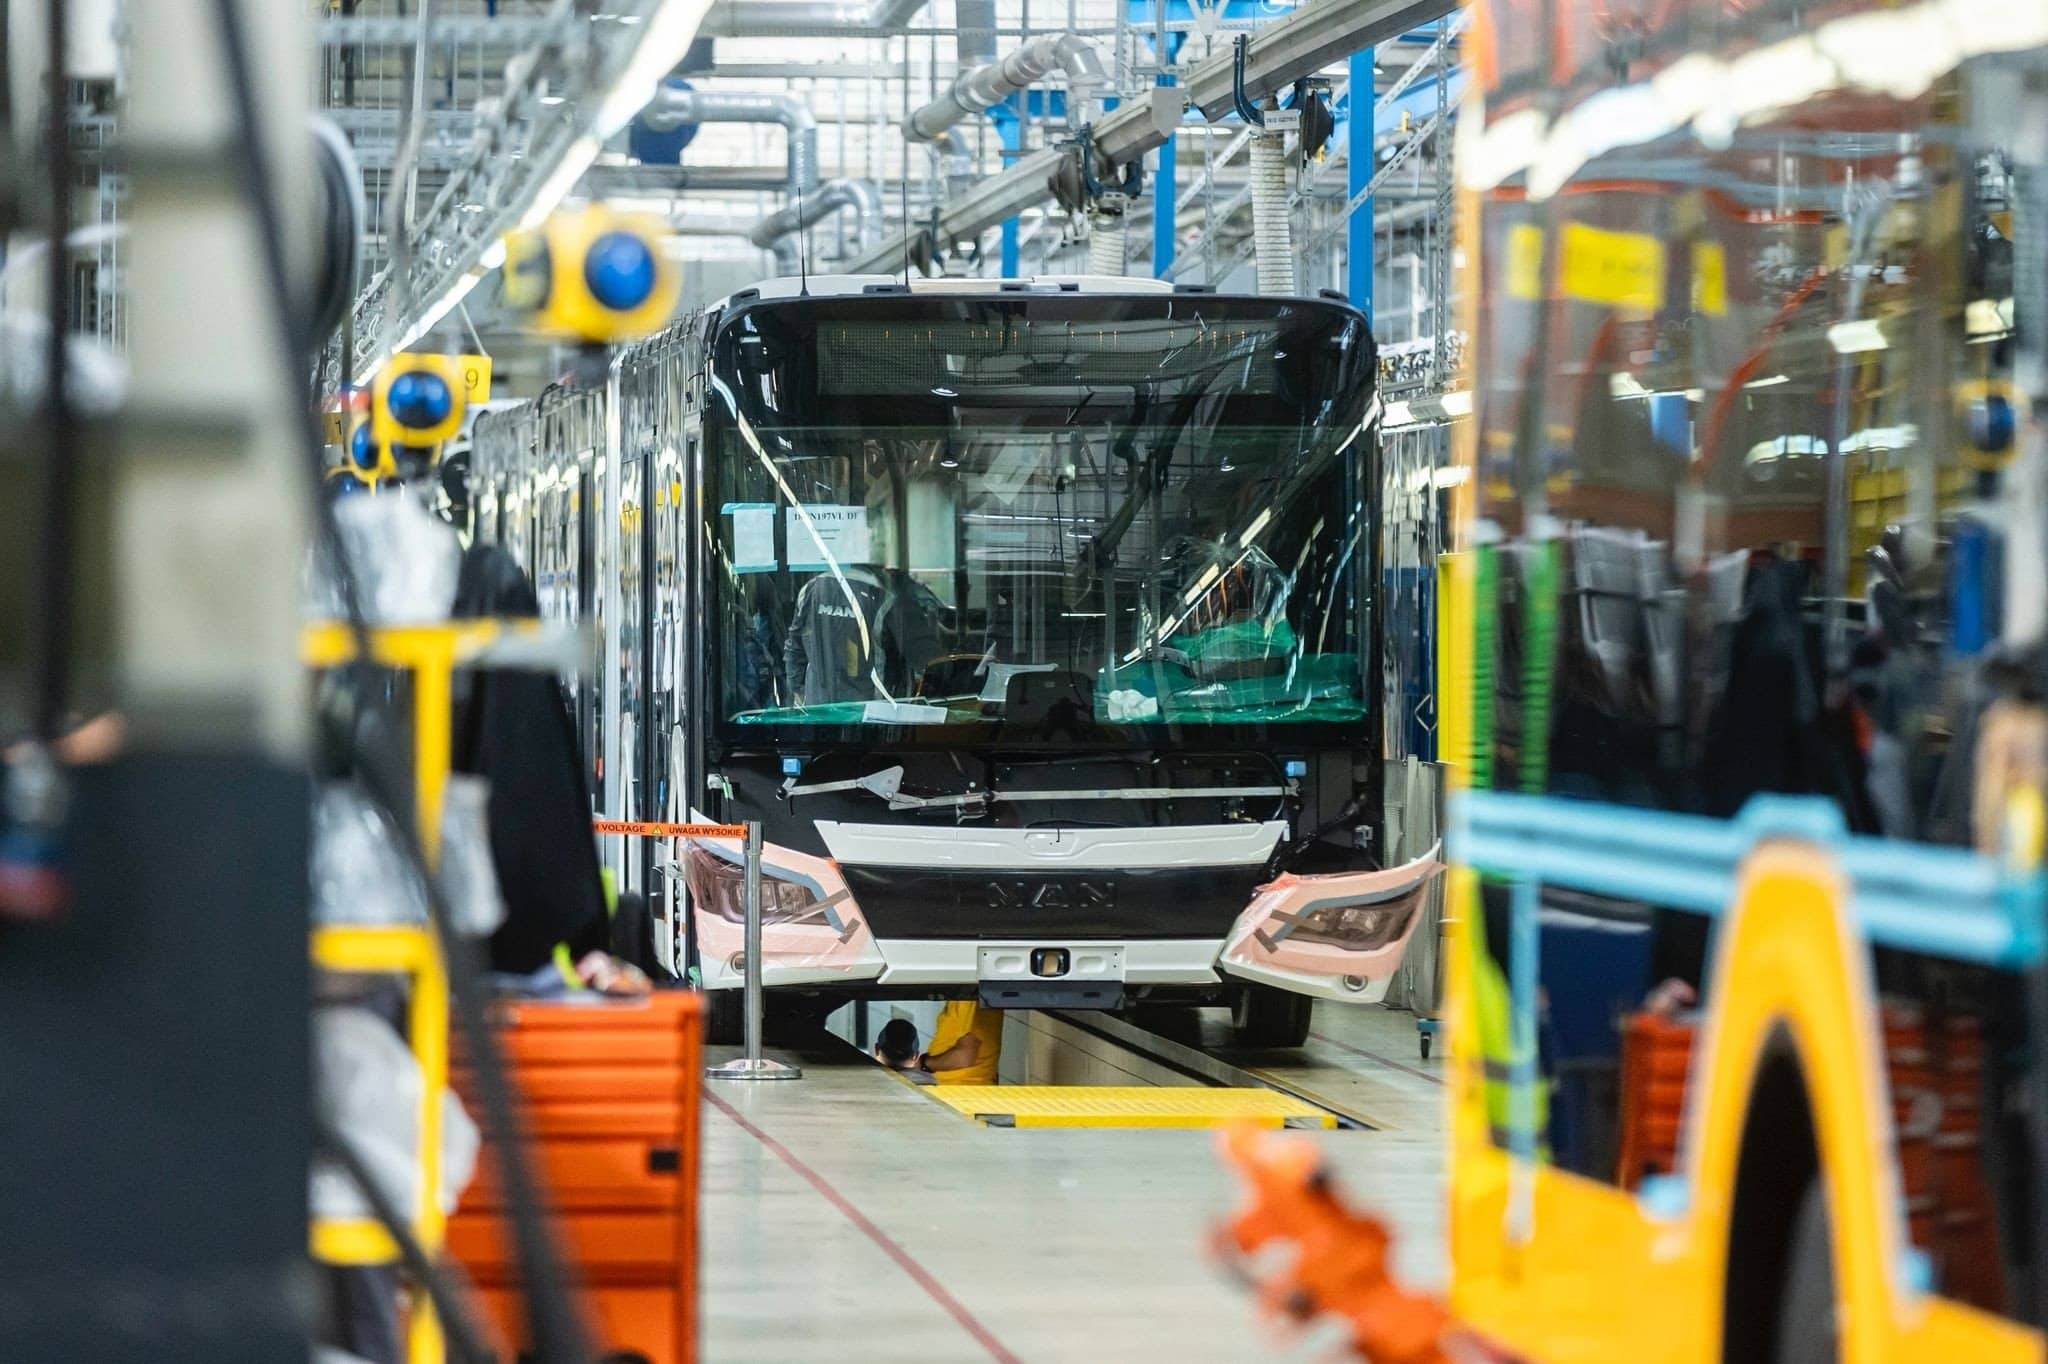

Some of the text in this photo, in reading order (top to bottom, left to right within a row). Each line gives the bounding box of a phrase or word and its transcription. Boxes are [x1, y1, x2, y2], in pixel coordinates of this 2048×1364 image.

[465, 367, 479, 391] 9
[818, 603, 856, 618] MAN
[601, 823, 646, 833] VOLTAGE
[669, 826, 700, 835] UWAGA
[702, 827, 742, 837] WYSOKIE
[989, 882, 1115, 908] MAN
